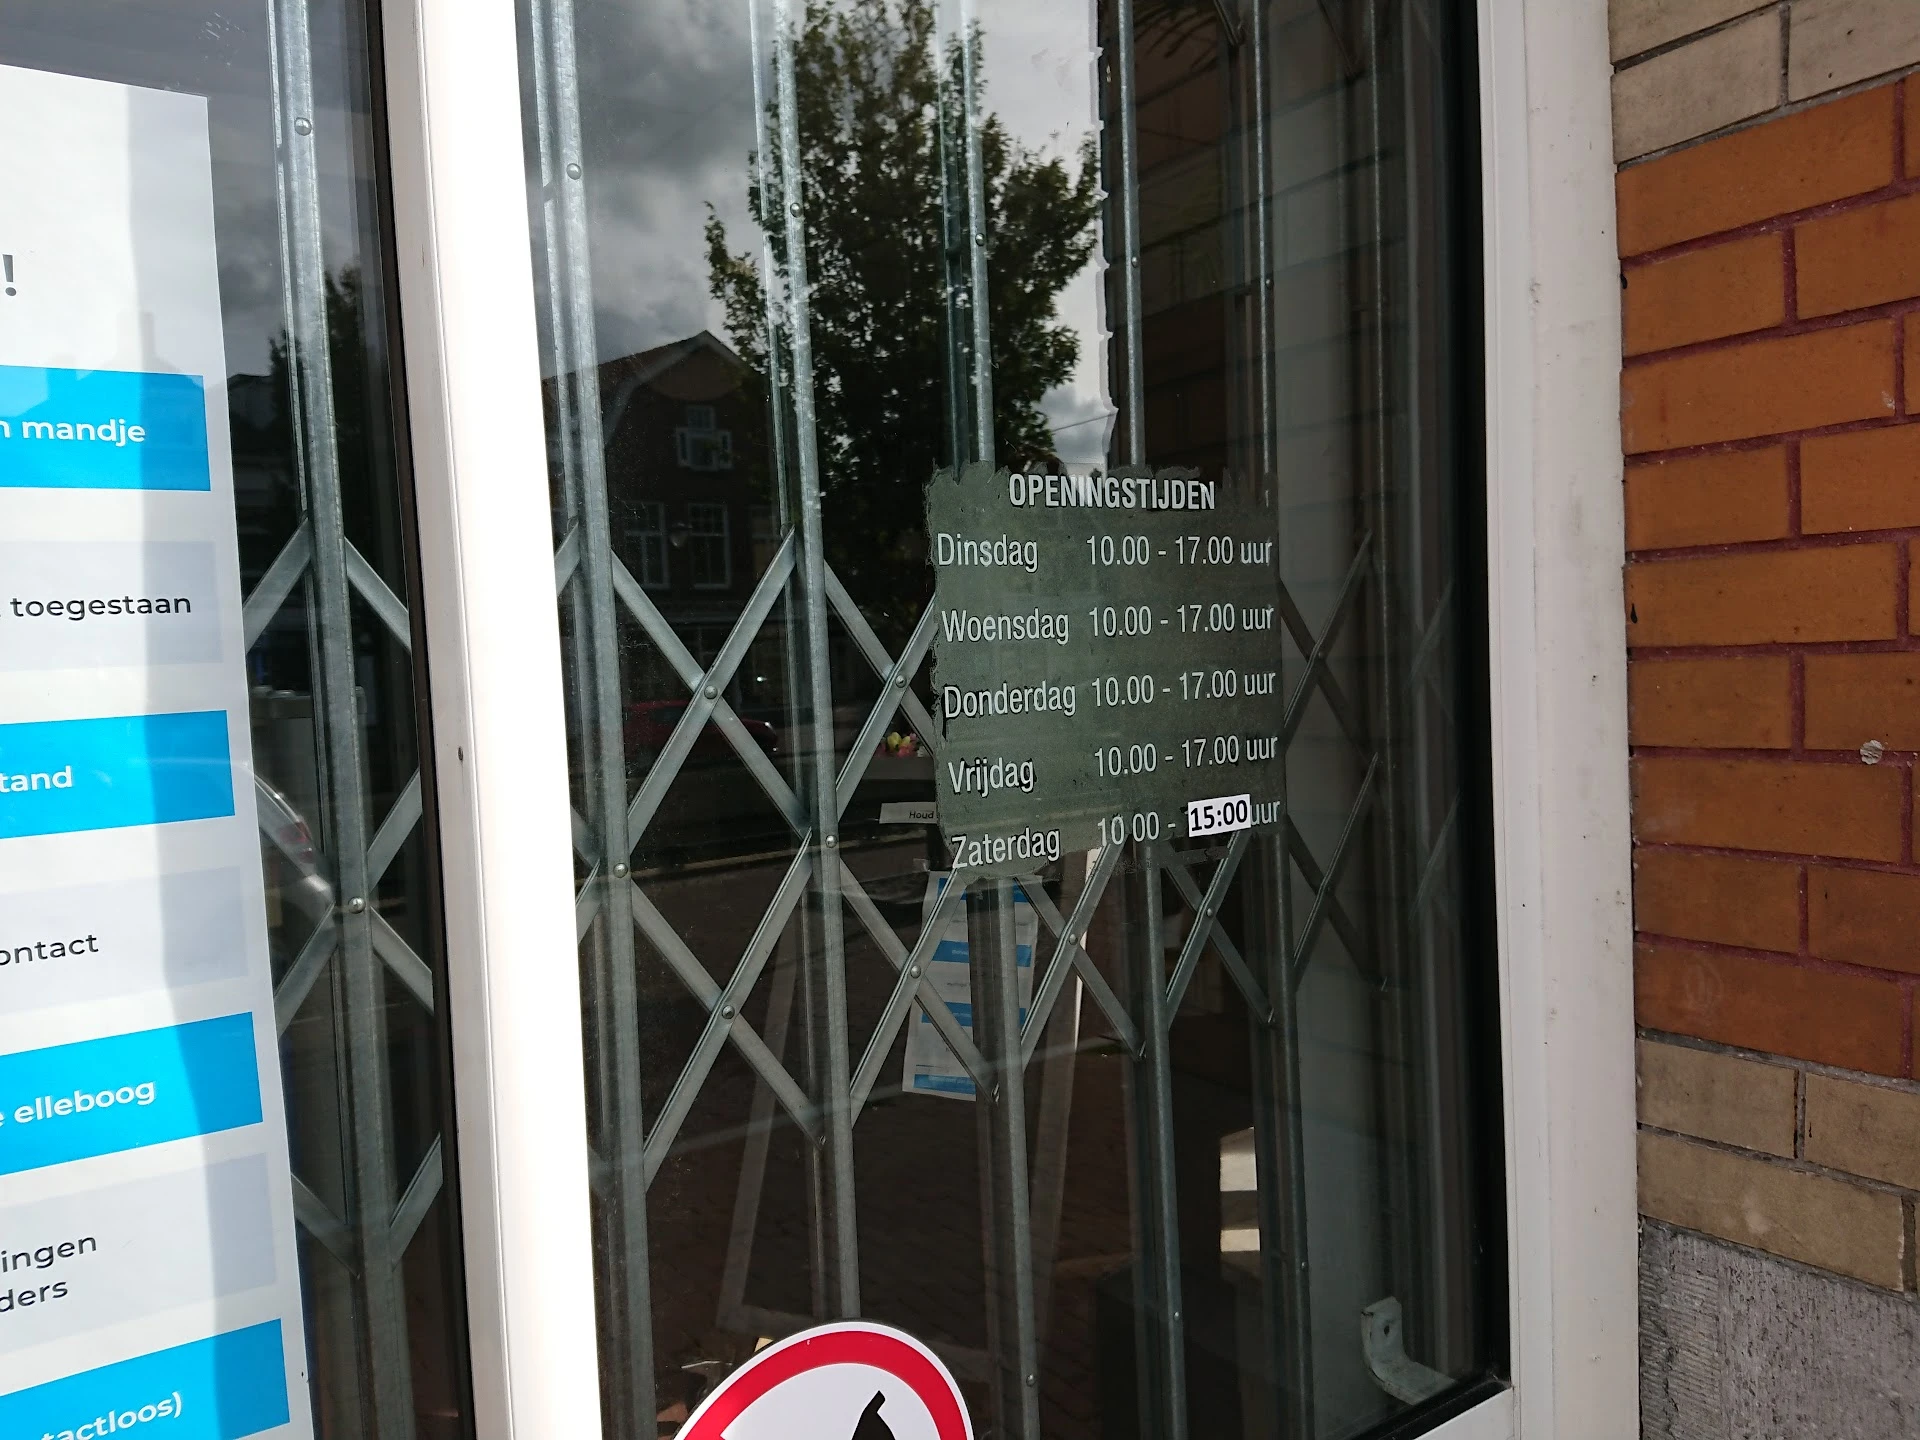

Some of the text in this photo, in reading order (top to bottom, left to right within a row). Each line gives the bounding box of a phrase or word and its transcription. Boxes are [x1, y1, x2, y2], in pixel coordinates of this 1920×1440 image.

[22, 418, 146, 447] mandje
[1008, 473, 1216, 510] OPENINGSTIJDEN
[937, 533, 1039, 573] Dinsdag
[1086, 535, 1150, 566] 10.00
[1175, 535, 1234, 565] 17.00
[1240, 538, 1273, 565] uur
[10, 592, 192, 621] toegestaan
[941, 607, 1070, 645] Woensdag
[1089, 605, 1153, 637] 10.00
[1177, 603, 1236, 633] 17.00
[1242, 605, 1275, 631] uur
[943, 680, 1077, 719] Donderdag
[1091, 674, 1155, 707] 10.00
[1179, 669, 1238, 701] 17.00
[1244, 671, 1276, 697] uur
[0, 765, 73, 793] tand
[948, 757, 1035, 798] Vrijdag
[1094, 743, 1158, 777] 10.00
[1181, 735, 1240, 769] 17.00
[1246, 735, 1278, 762] uur
[909, 810, 934, 820] Houd
[951, 828, 1061, 870] Zaterdag
[1189, 799, 1249, 832] 15:00
[1249, 800, 1281, 827] uur
[14, 1080, 156, 1124] elleboog
[1, 1236, 97, 1273] ingen
[0, 1281, 69, 1313] ders
